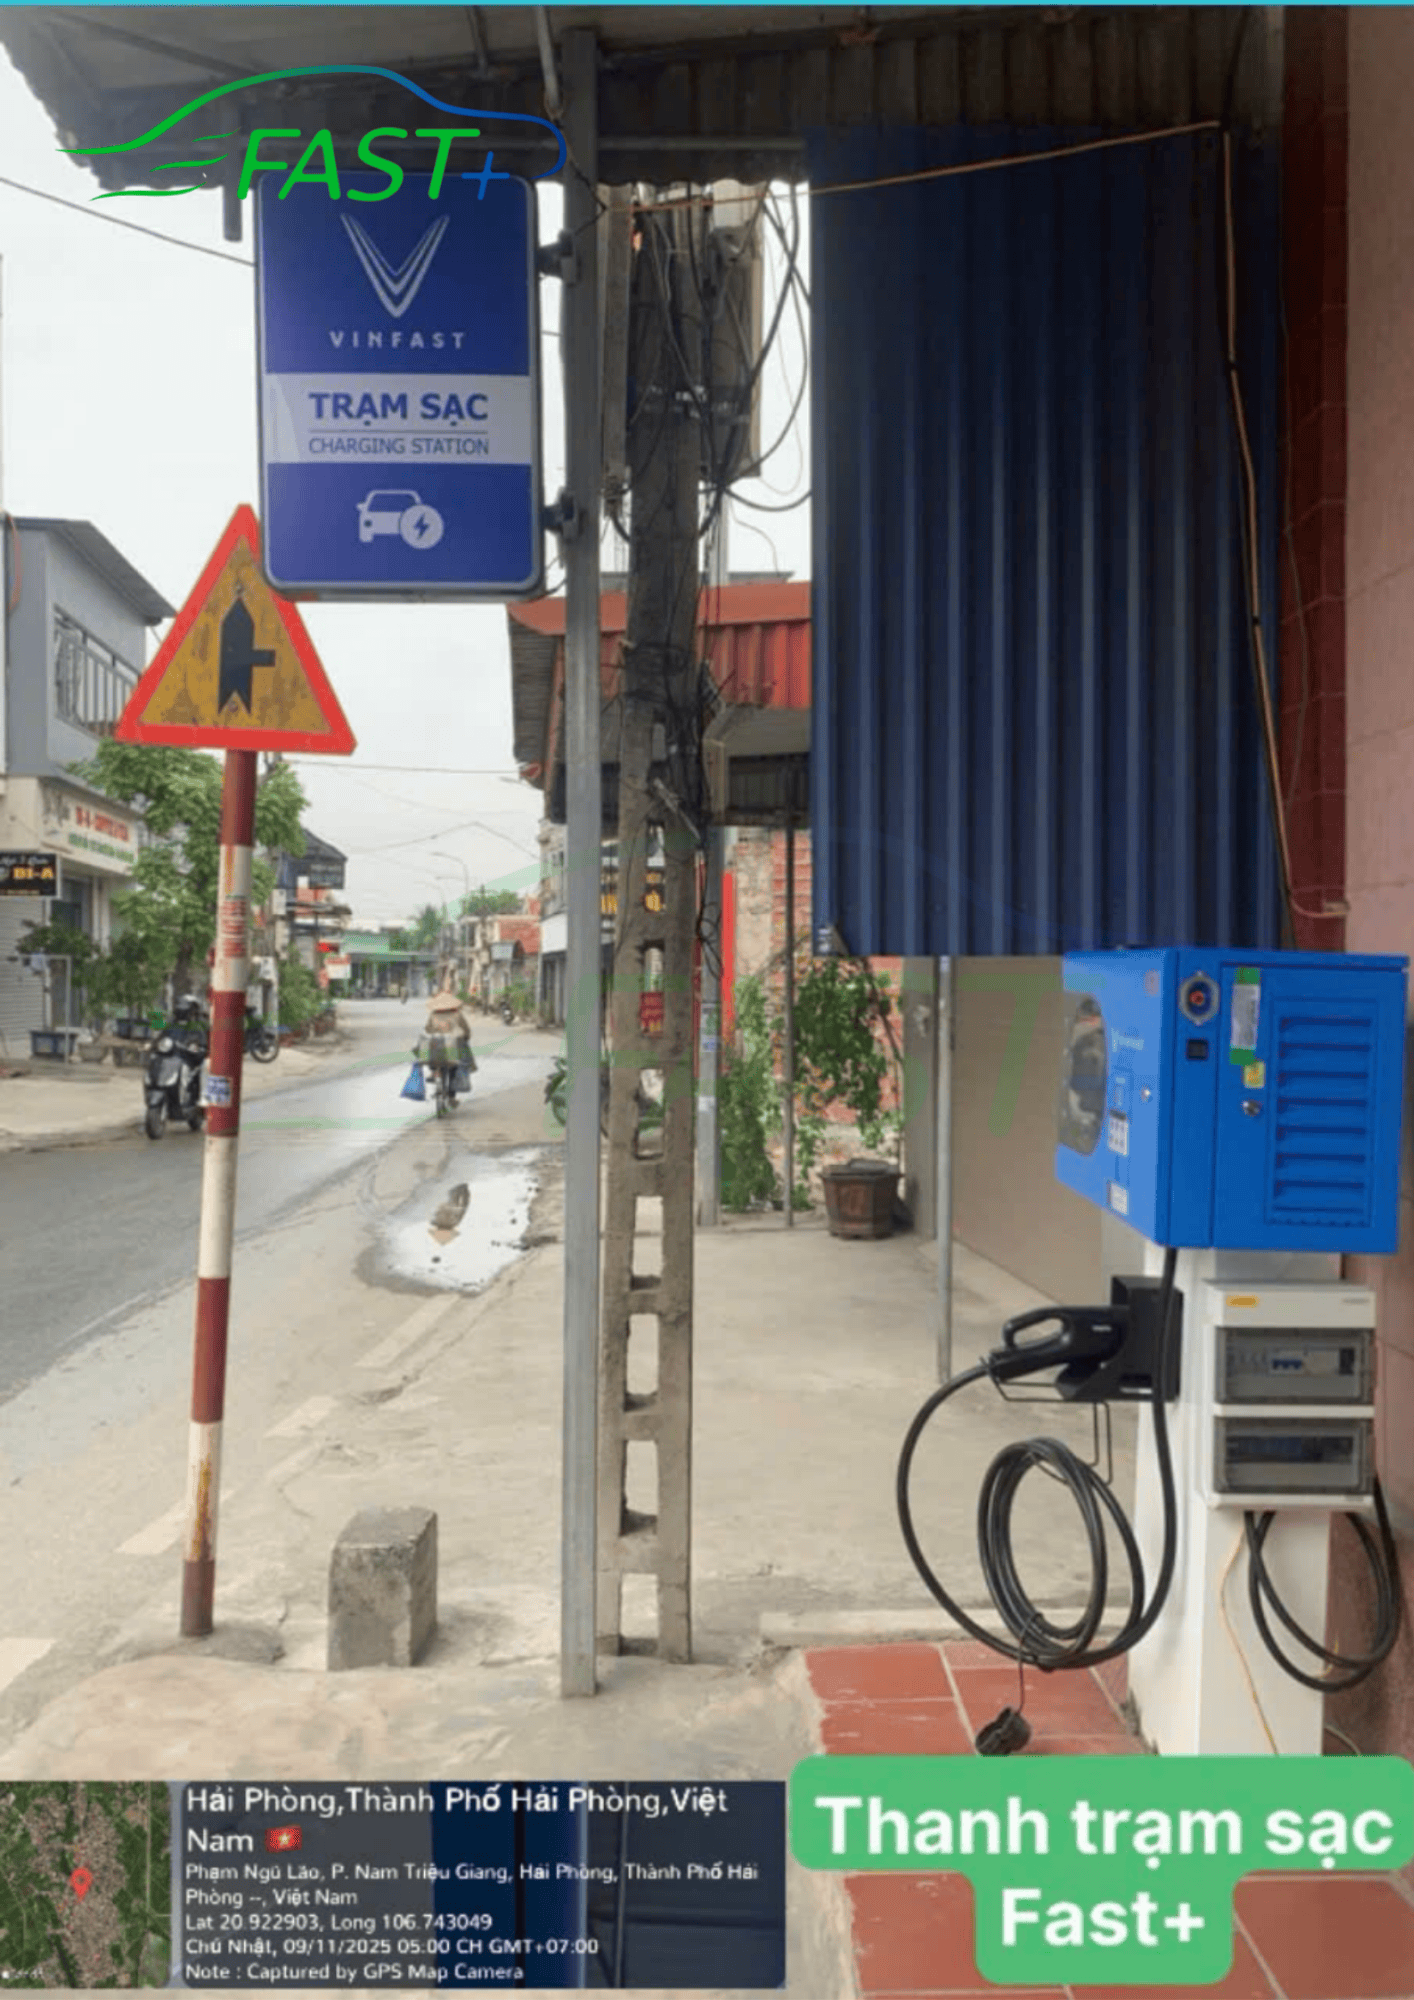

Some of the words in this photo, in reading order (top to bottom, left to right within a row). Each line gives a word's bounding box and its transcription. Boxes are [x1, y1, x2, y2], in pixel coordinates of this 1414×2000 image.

[329, 330, 465, 349] VINFAST
[308, 391, 409, 427] TRẠM
[420, 391, 489, 427] SẠC
[308, 437, 406, 455] CHARGING
[410, 437, 490, 456] STATION
